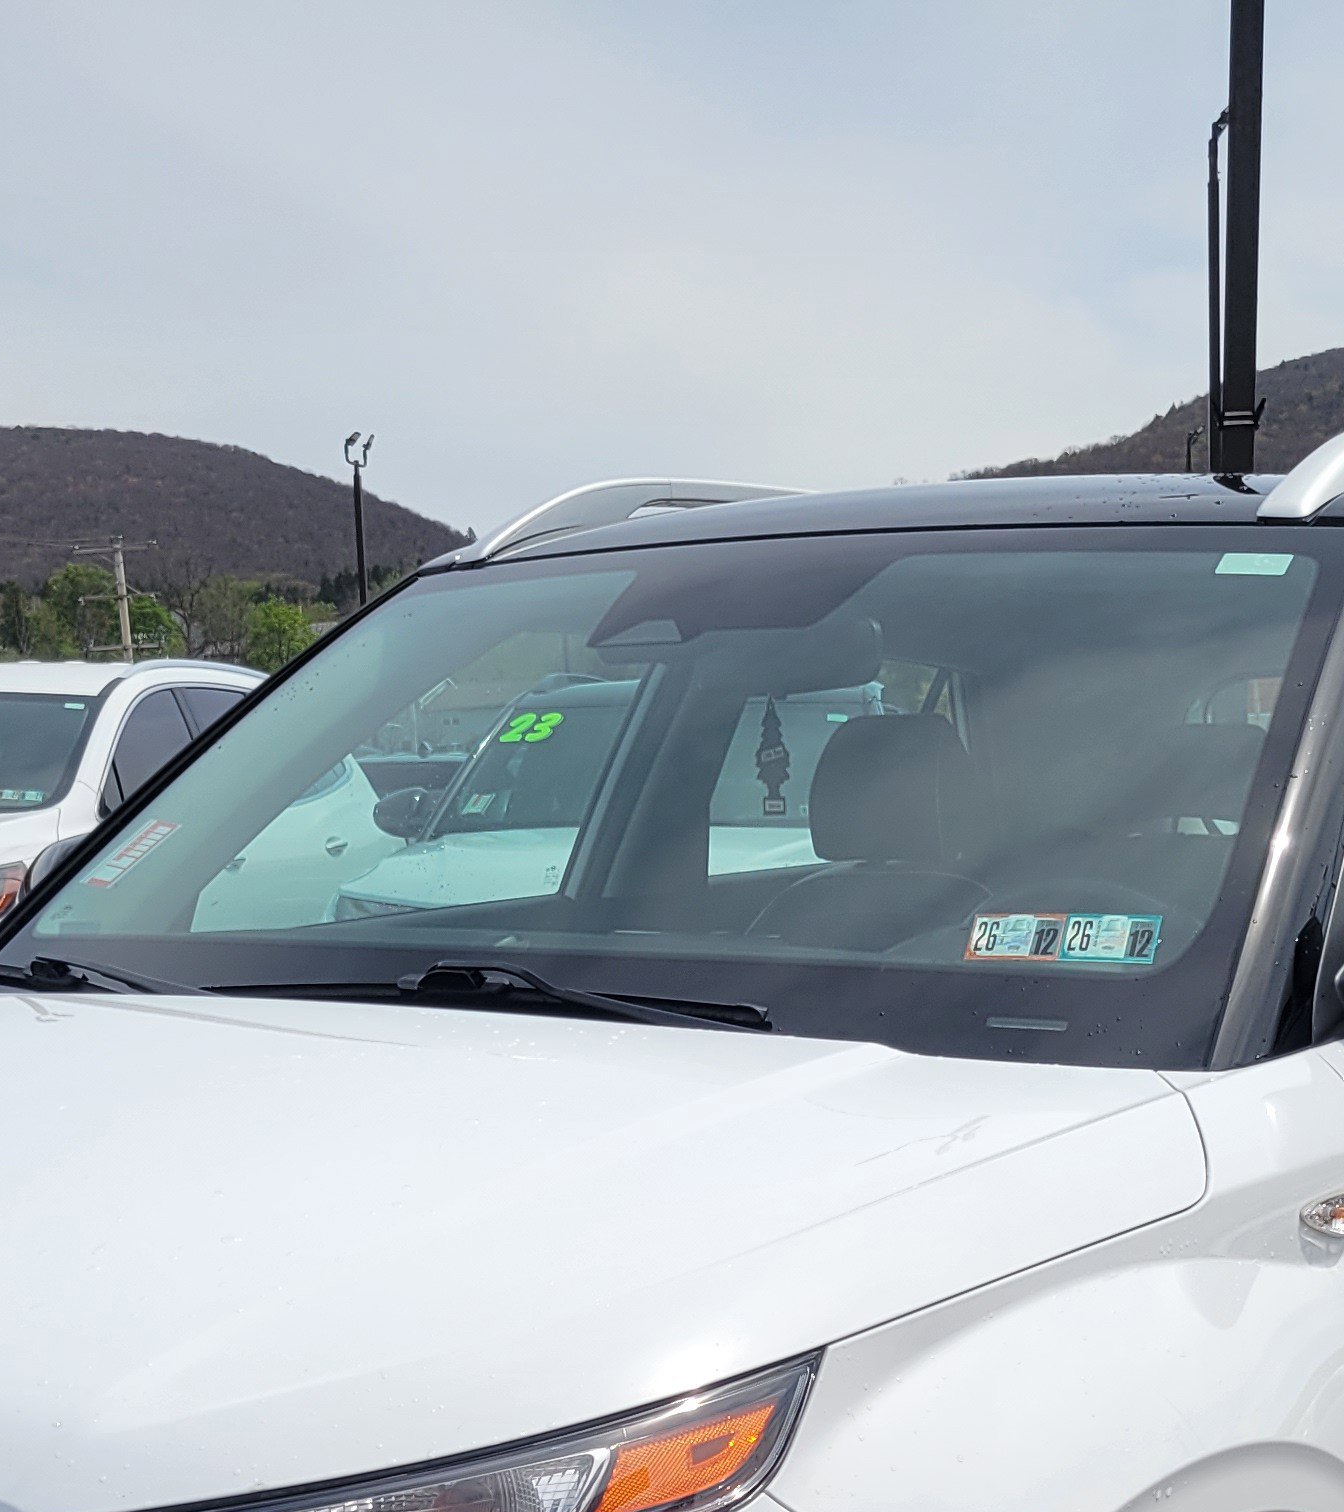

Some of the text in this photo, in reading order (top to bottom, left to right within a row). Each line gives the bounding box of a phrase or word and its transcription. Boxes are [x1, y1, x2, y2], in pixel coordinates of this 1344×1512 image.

[499, 712, 564, 742] 23
[973, 921, 1059, 955] 26 12
[1066, 920, 1154, 957] 26 12
